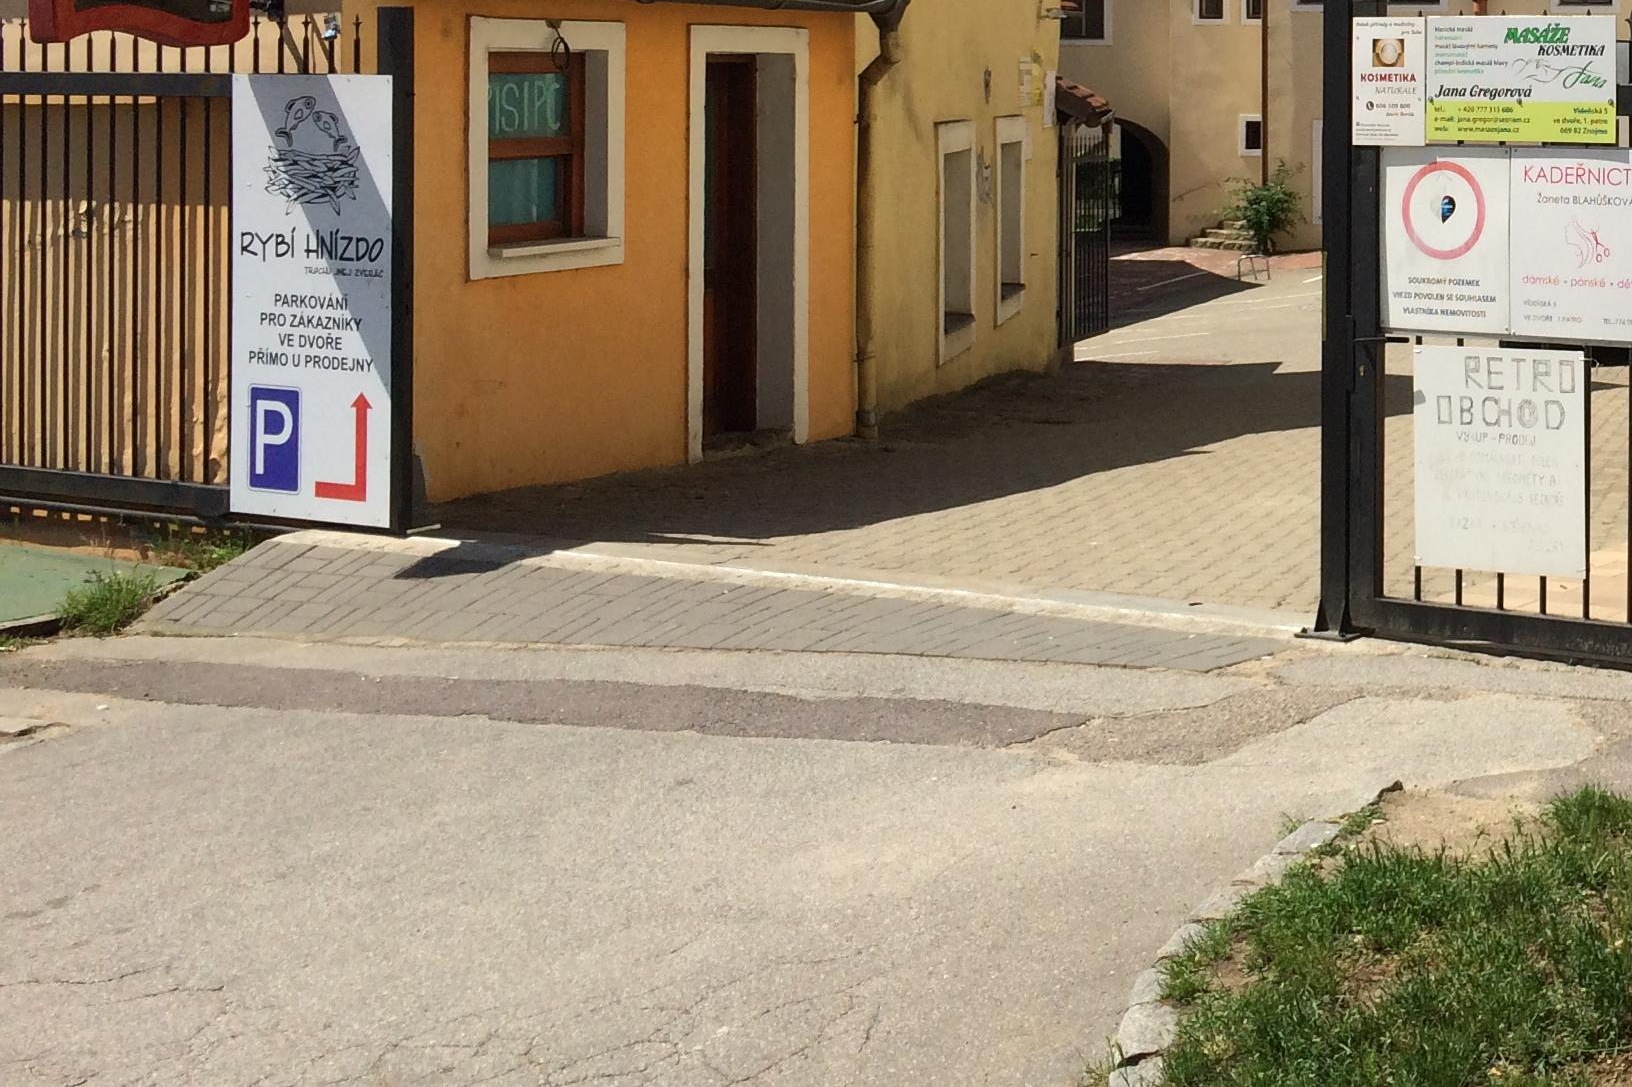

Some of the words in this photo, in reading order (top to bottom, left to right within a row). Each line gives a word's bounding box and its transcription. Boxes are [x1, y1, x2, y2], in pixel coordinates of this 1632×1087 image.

[1504, 23, 1571, 44] MASÁŽE
[1537, 44, 1606, 56] KOSMETIKA
[1360, 73, 1417, 82] KOSMETIKA
[1435, 84, 1467, 98] Jana
[1470, 84, 1533, 100] Gregorová
[240, 226, 296, 262] RYBÍ
[304, 228, 385, 263] HNÍZDO
[274, 293, 349, 311] PARKOVÁNÍ
[260, 312, 287, 327] PRO
[289, 310, 363, 331] ZÁKAZNÍKY
[278, 333, 295, 347] VE
[298, 332, 343, 351] DVOŘE
[248, 347, 289, 367] PŘÍMO
[292, 354, 301, 368] U
[304, 354, 374, 373] PRODEJNY
[1464, 355, 1576, 394] RETRO
[1436, 394, 1566, 431] OBCHOD
[254, 399, 294, 475] P
